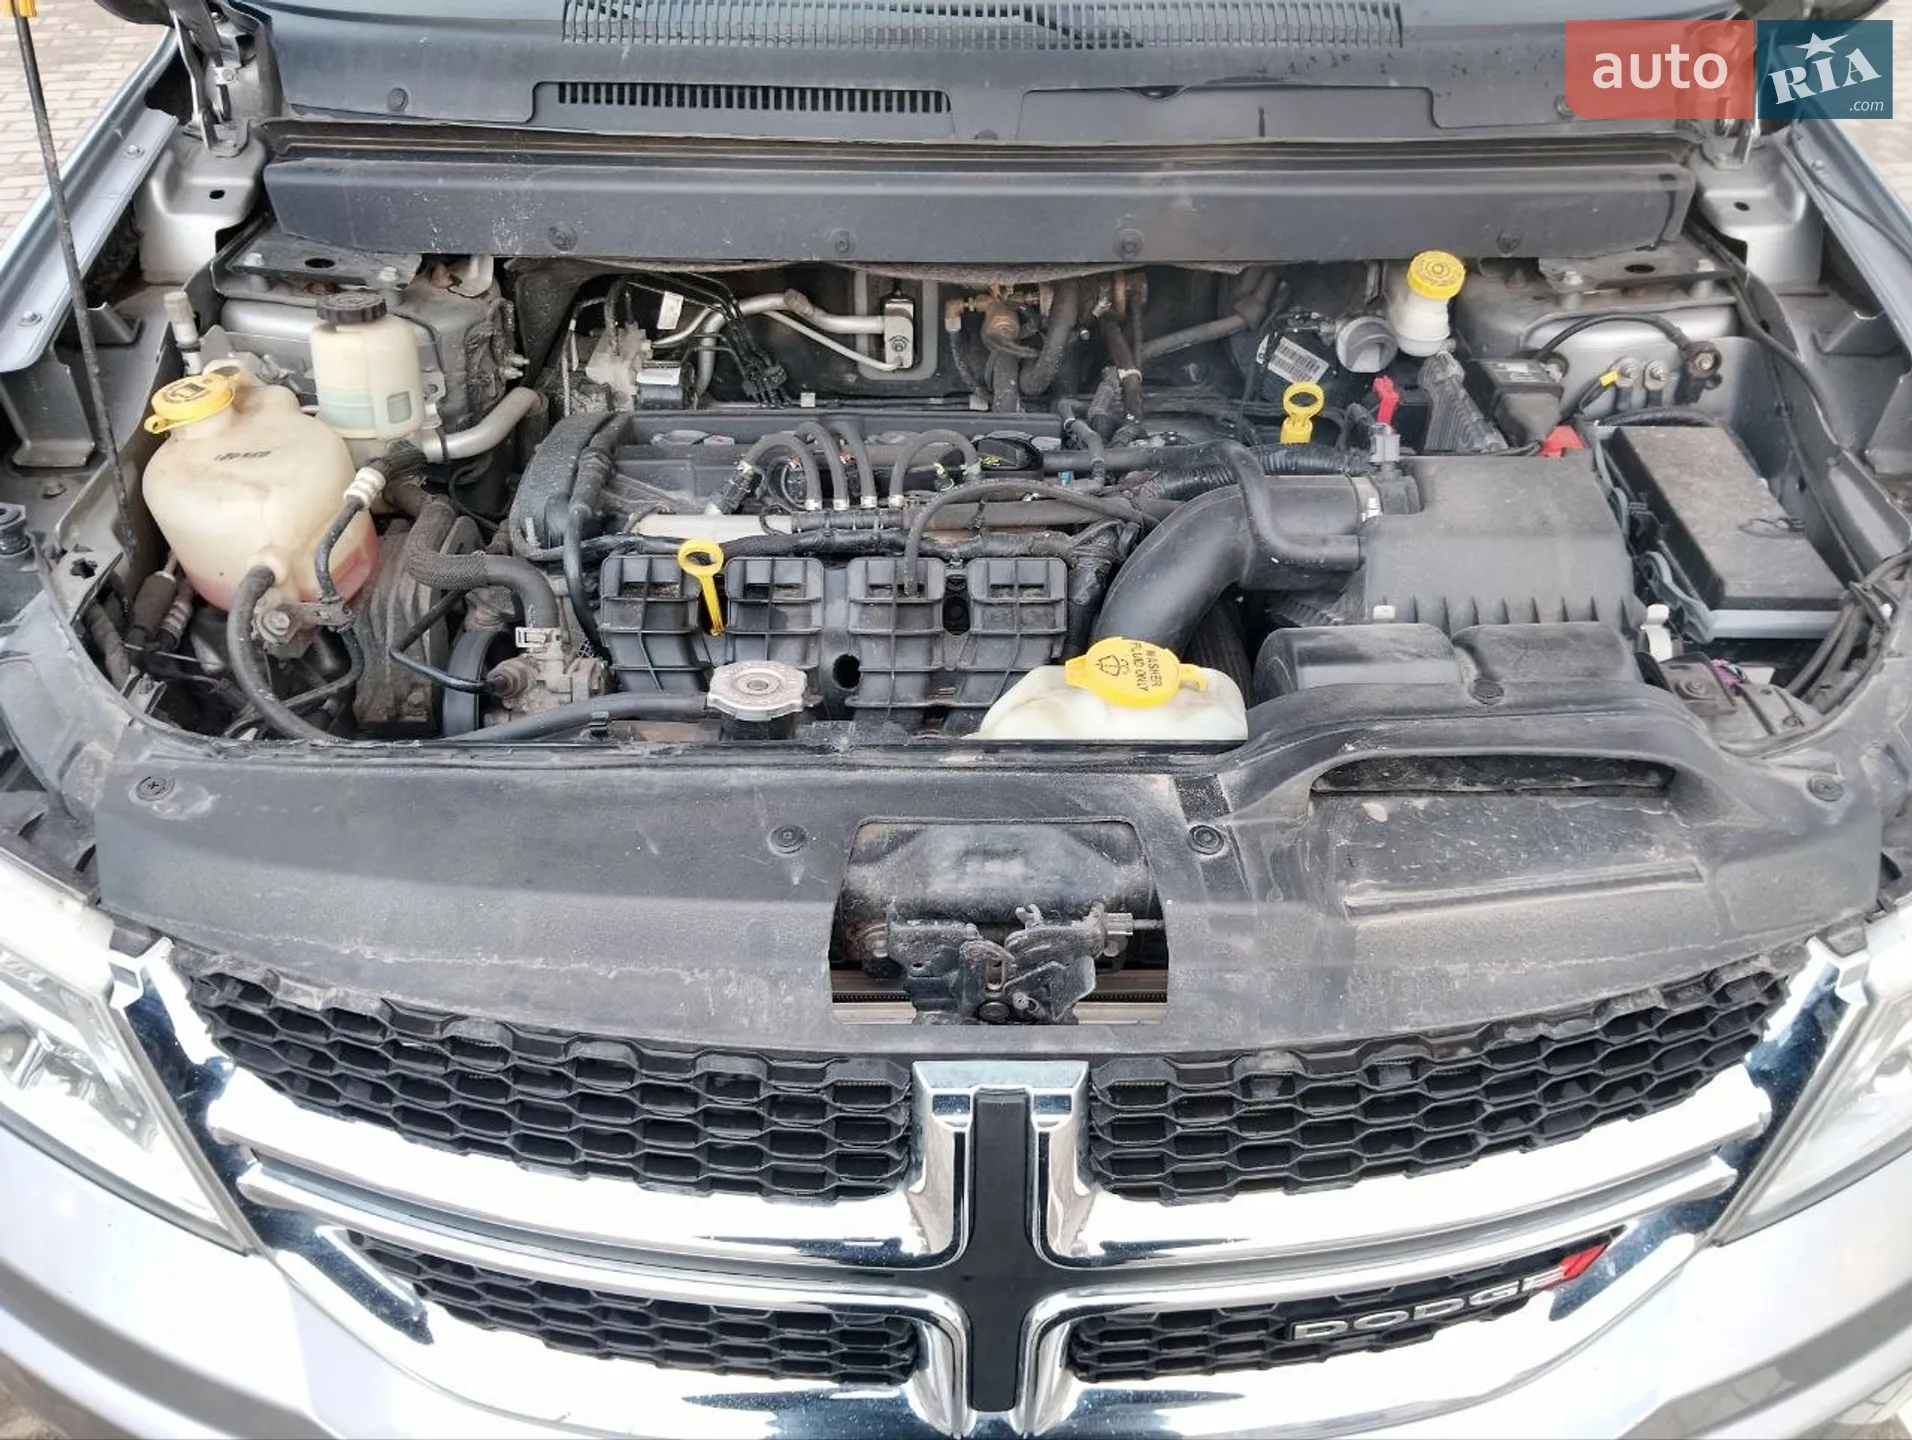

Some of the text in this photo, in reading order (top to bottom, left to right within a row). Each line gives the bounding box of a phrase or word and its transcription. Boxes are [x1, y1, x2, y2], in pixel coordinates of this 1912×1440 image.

[1130, 642, 1149, 692] FLUID ONLY
[1146, 650, 1163, 687] WASHER
[1293, 1267, 1567, 1340] DODGE
